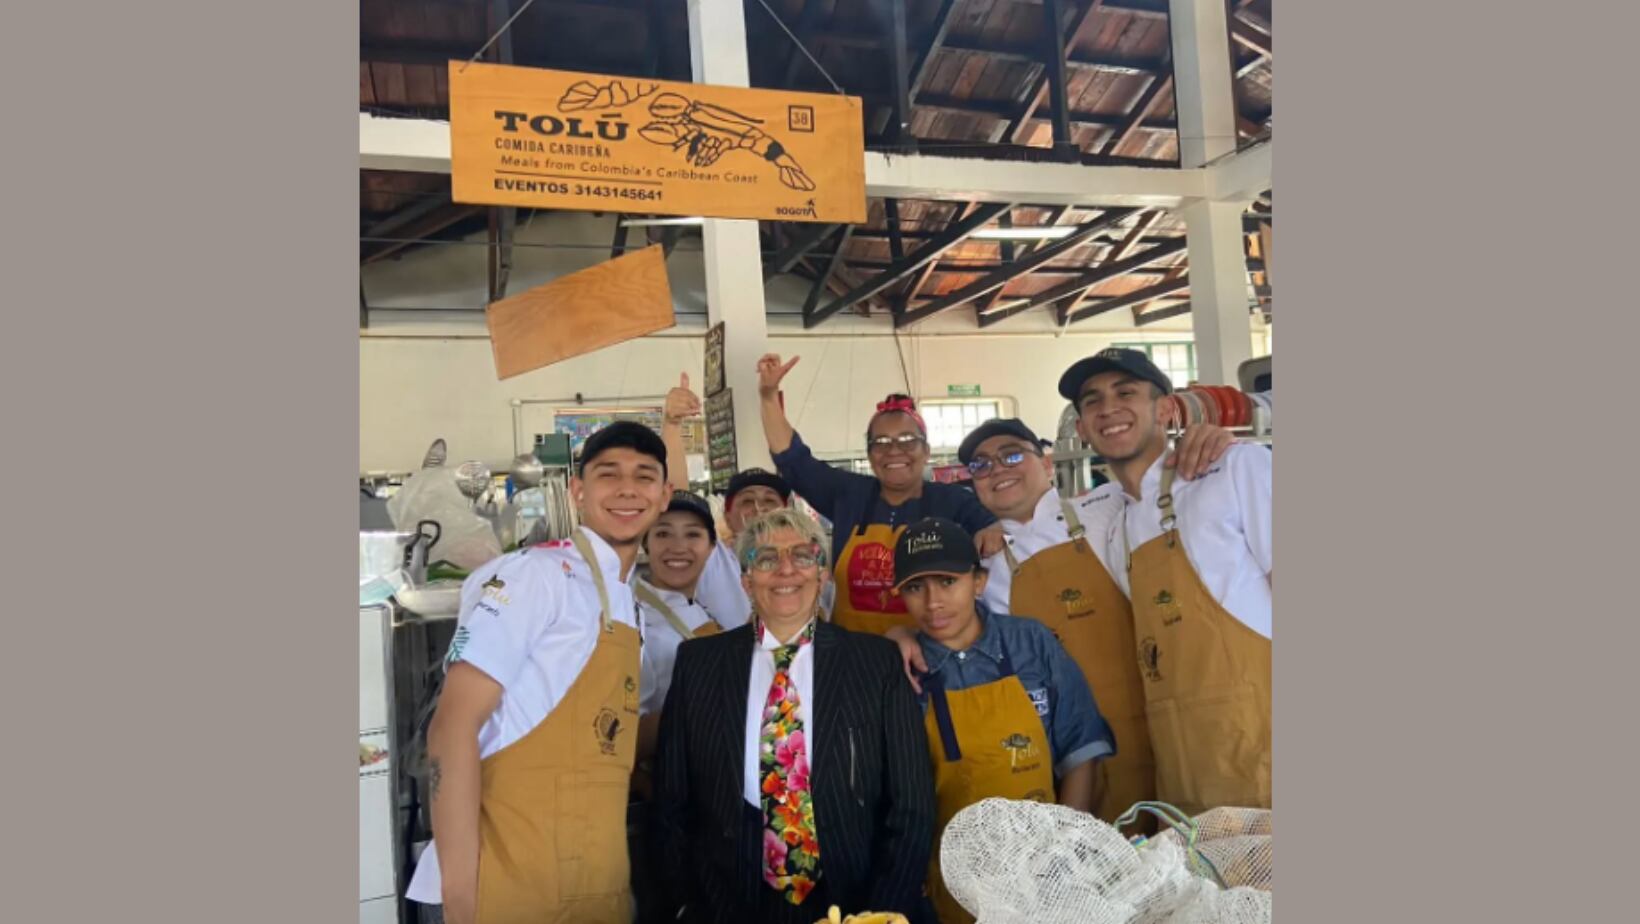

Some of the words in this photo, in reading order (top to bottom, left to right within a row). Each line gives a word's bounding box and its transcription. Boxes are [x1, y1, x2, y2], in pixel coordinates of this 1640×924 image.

[791, 111, 808, 126] 38
[494, 137, 545, 153] COMIDA
[549, 142, 611, 158] CARIBEÑA
[501, 155, 540, 168] Meals
[545, 158, 575, 171] from
[579, 161, 652, 177] Colombia's
[656, 167, 720, 183] Caribbean
[724, 172, 759, 184] Coast
[494, 178, 569, 194] EVENTOS
[575, 184, 663, 201] 3143145641
